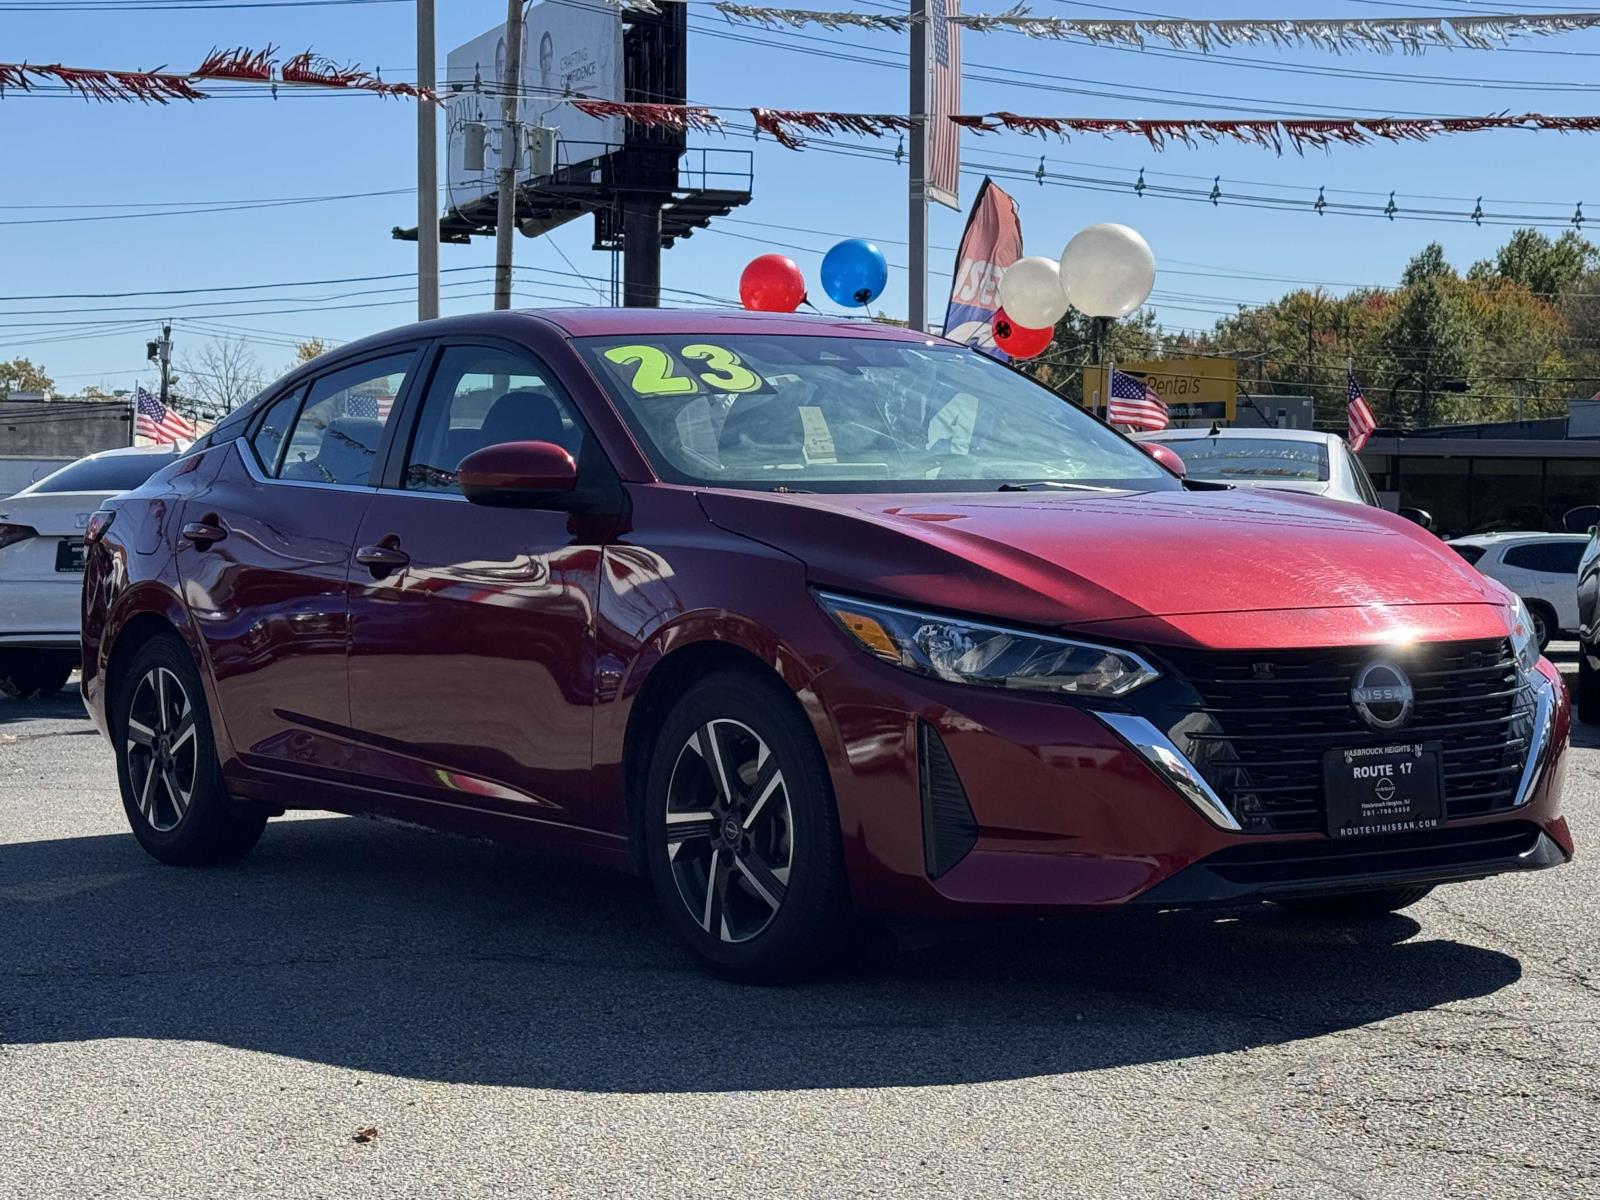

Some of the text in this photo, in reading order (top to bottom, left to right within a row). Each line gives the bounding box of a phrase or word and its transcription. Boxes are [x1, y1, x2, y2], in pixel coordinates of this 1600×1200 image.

[604, 344, 762, 395] 23
[1353, 689, 1411, 701] NISSAN
[1344, 747, 1384, 758] HASBROUCK
[1353, 762, 1412, 779] ROUTE 17
[1340, 819, 1437, 837] ROUTE17NISSAN.COM
